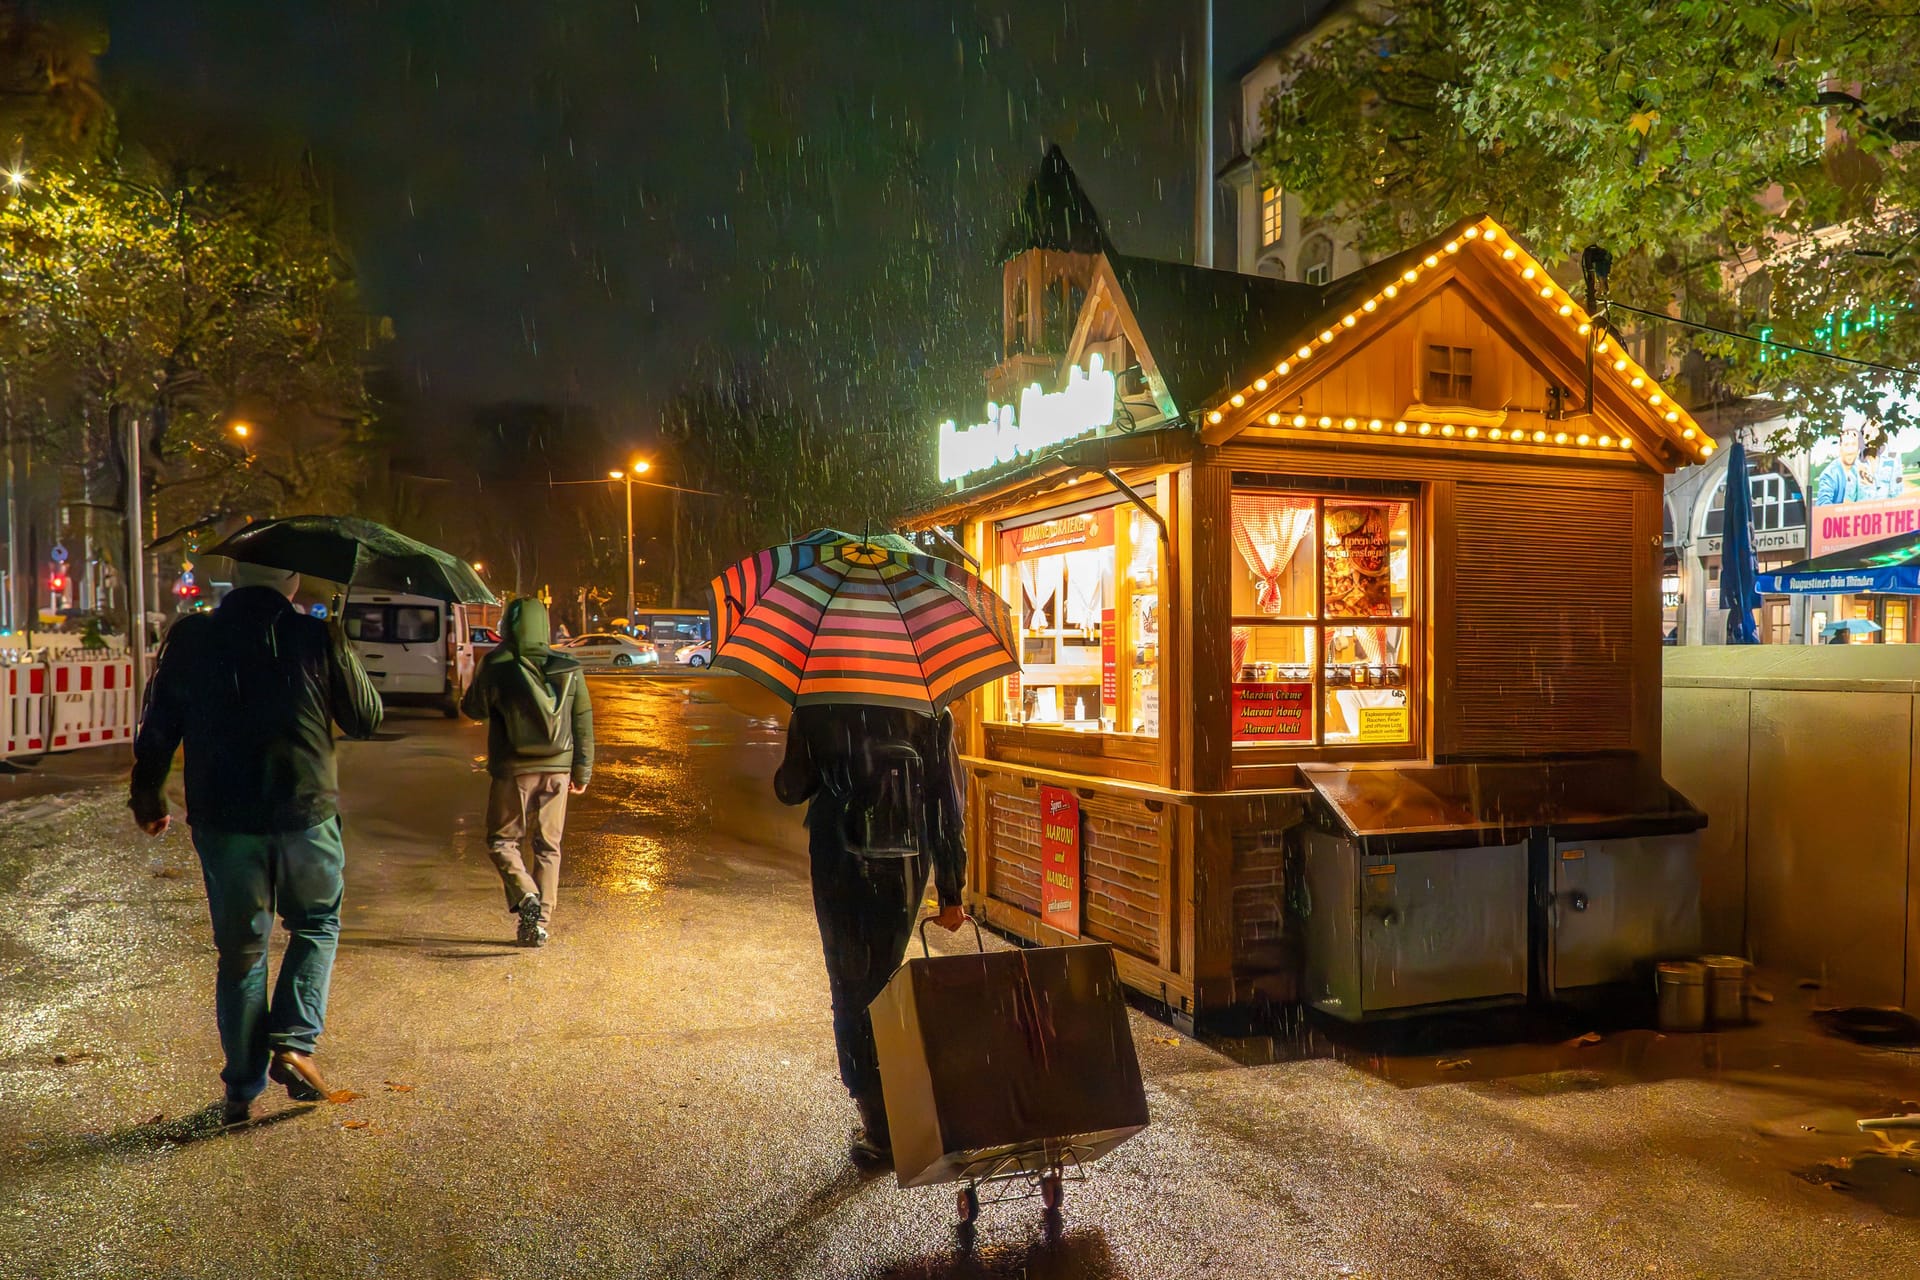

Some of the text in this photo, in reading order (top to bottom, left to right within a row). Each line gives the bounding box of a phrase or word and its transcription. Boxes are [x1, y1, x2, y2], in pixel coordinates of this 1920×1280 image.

[1823, 516, 1850, 539] ONE
[1853, 513, 1882, 536] FOR
[1885, 510, 1914, 534] THE
[1241, 689, 1302, 700] Maroni Creme
[1241, 704, 1302, 718] Maroni Honig
[1243, 722, 1301, 734] Maroni Mehl
[1045, 823, 1074, 846] MARONI
